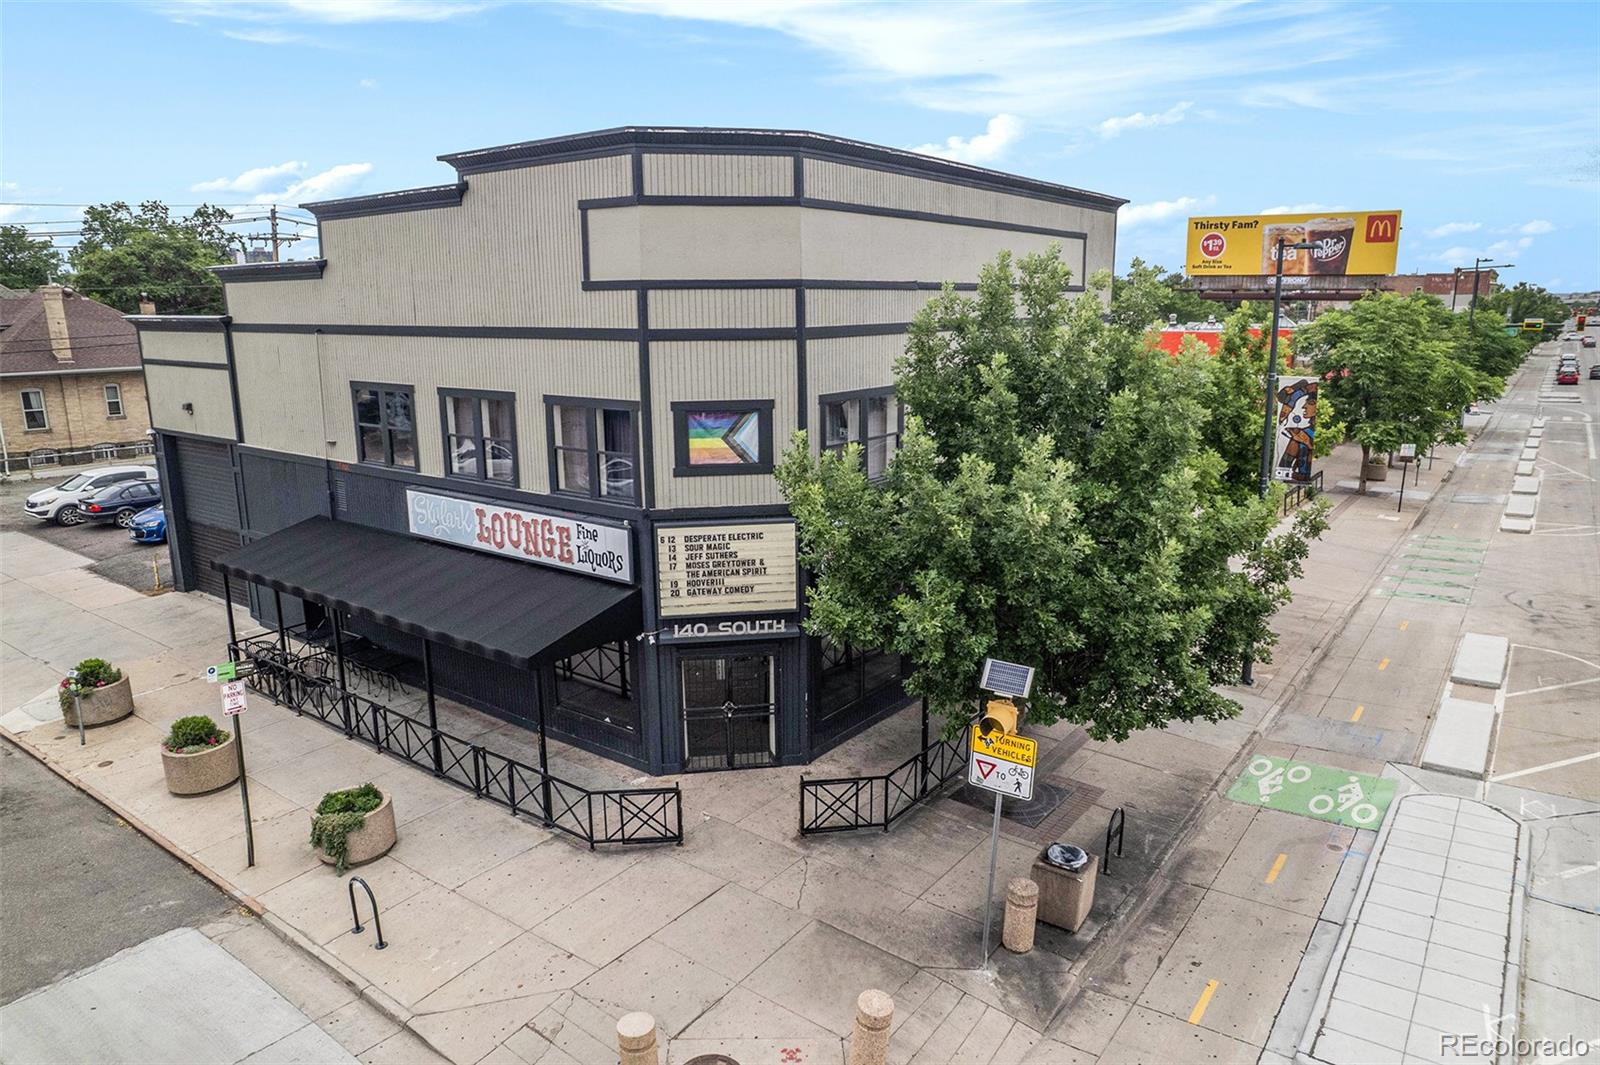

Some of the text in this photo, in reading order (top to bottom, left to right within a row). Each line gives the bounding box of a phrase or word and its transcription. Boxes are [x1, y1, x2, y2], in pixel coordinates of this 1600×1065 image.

[1194, 220, 1259, 231] Thirsty Fam?
[414, 495, 574, 565] Skylark LOUNGE
[576, 523, 598, 542] Fine
[684, 534, 726, 543] DESPERATE
[728, 532, 764, 541] ELECTRIC
[668, 542, 731, 553] 13 SOUR MAGIC
[668, 551, 738, 562] 14 JEFF SUTHERS
[669, 558, 765, 571] 17 MOSES GREYTOWER &
[686, 567, 768, 578] THE AMERICAN SPIRIT
[670, 580, 679, 589] 19
[670, 585, 755, 597] 20 GATEWAY COMEDY
[673, 619, 786, 638] 140 SOUTH
[223, 690, 244, 699] PARKING
[994, 736, 1031, 751] TURNING
[992, 746, 1031, 763] VEHICLES
[996, 771, 1006, 781] TO
